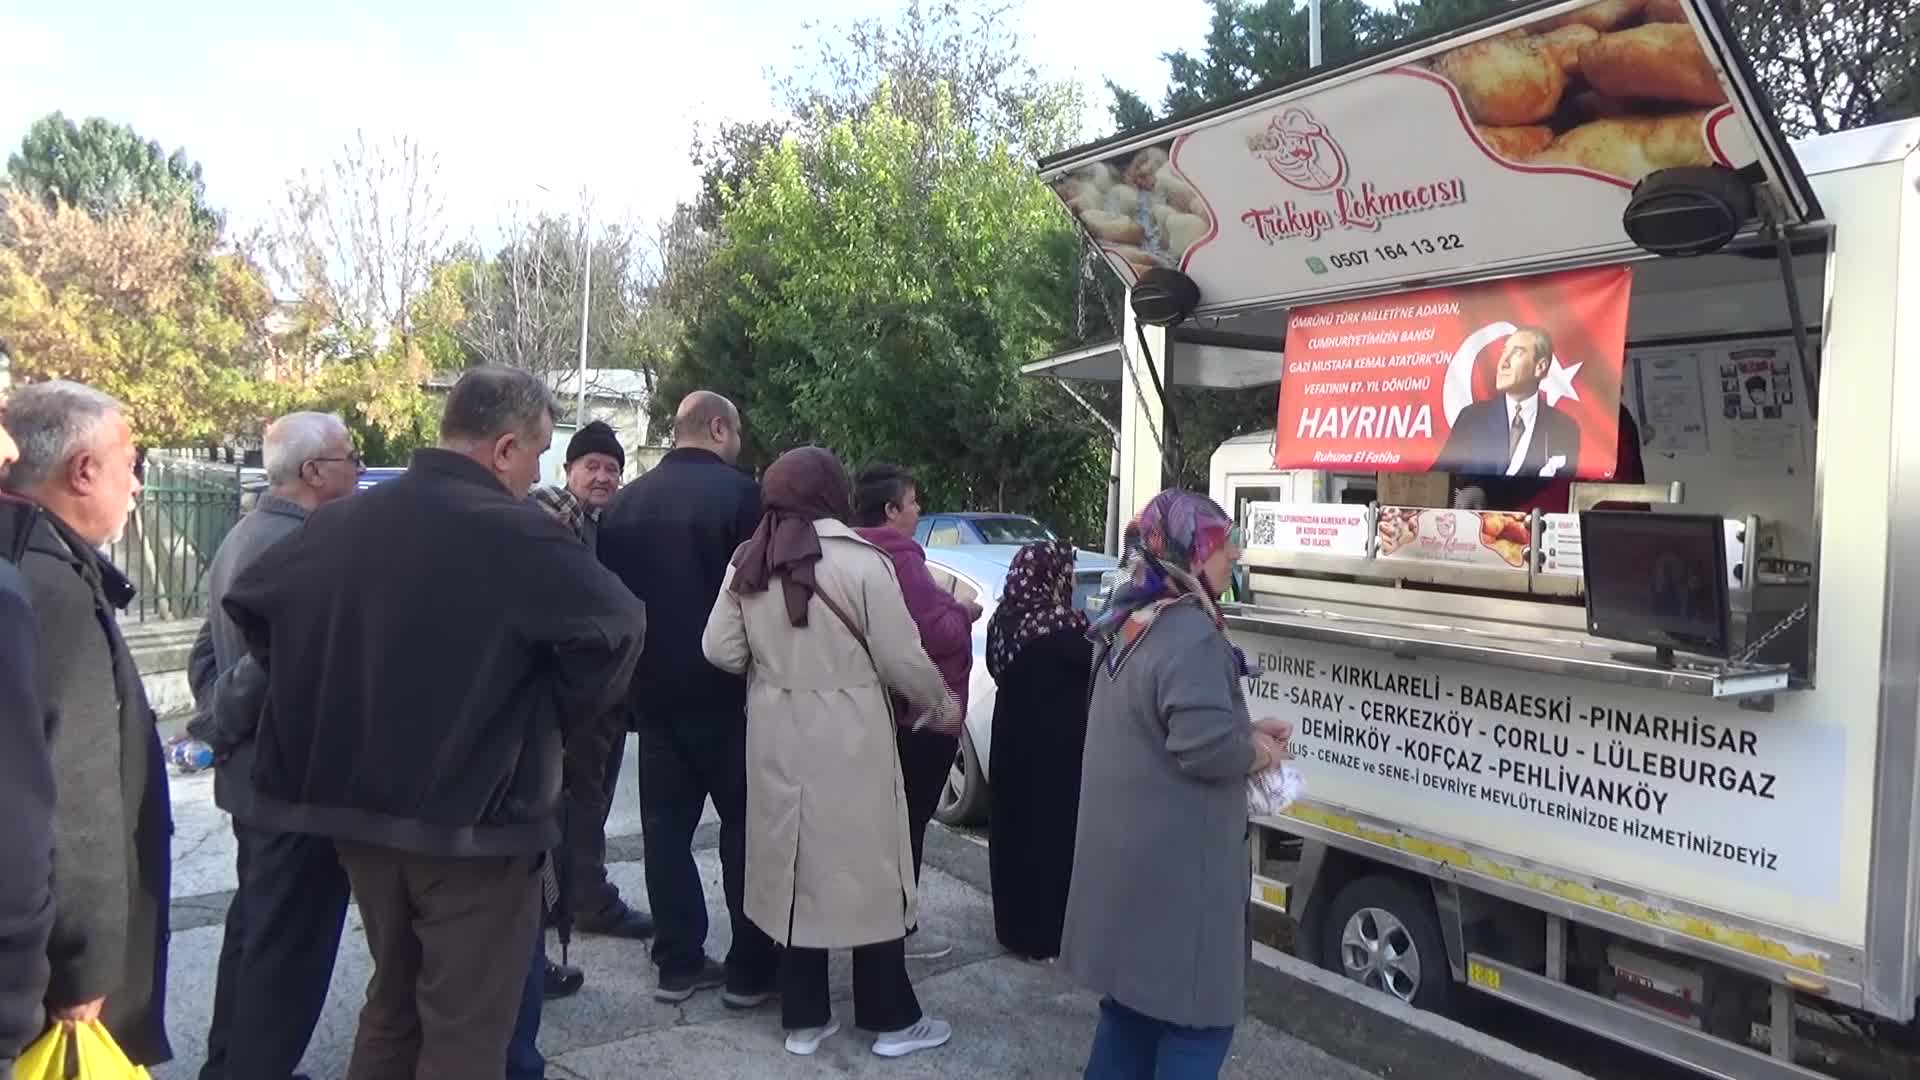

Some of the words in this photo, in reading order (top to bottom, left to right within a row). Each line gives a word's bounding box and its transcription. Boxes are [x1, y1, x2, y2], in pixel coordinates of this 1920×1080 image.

[1241, 202, 1331, 241] Trakya
[1335, 178, 1462, 230] Lokmacısı
[1330, 250, 1370, 269] 0507
[1376, 243, 1408, 261] 164
[1411, 239, 1435, 256] 13
[1437, 234, 1464, 250] 22
[1335, 310, 1360, 325] TÜRK
[1289, 360, 1311, 373] GAZİ
[1312, 358, 1352, 372] MUSTAFA
[1354, 356, 1386, 369] KEMAL
[1304, 382, 1350, 395] VEFATININ
[1350, 381, 1364, 393] 87.
[1366, 380, 1380, 392] YIL
[1382, 375, 1431, 392] DÖNÜMÜ
[1296, 404, 1432, 438] HAYRINA
[1312, 450, 1353, 463] Ruhuna
[1353, 451, 1366, 463] El
[1366, 451, 1401, 463] Fatiha
[1257, 650, 1315, 679] EDİRNE
[1332, 664, 1440, 701] KIRKLARELİ
[1460, 685, 1571, 723] BABAESKİ
[1302, 716, 1391, 753] DEMİRKÖY
[1361, 700, 1473, 737] ÇERKEZKÖY
[1493, 725, 1569, 758] ÇORLU
[1593, 739, 1776, 799] LÜLEBURGAZ
[1318, 748, 1360, 770] CENAZE
[1363, 761, 1376, 774] ve
[1423, 773, 1477, 799] DEVRİYE
[1481, 786, 1618, 832] MEVLÜTLERİNİZDE
[1623, 819, 1778, 871] HİZMETİNİZDEYİZ
